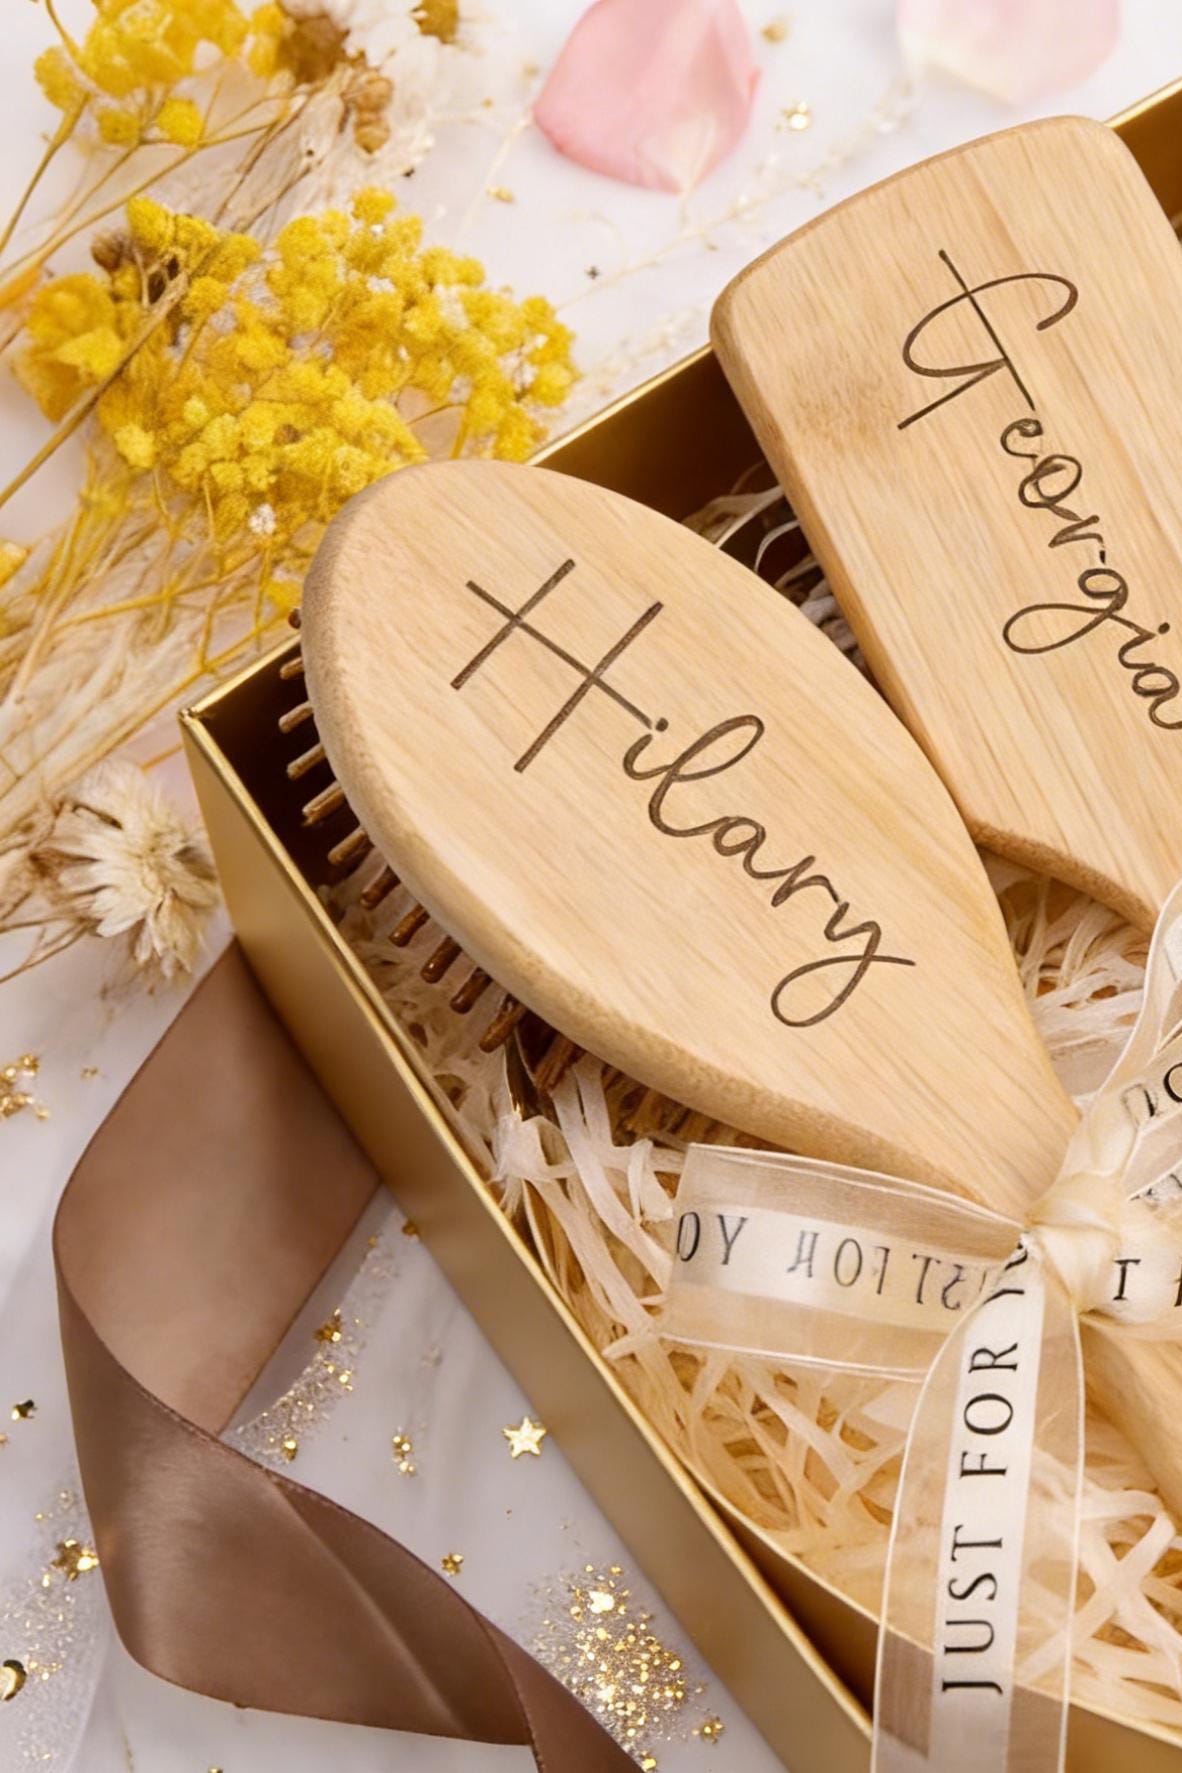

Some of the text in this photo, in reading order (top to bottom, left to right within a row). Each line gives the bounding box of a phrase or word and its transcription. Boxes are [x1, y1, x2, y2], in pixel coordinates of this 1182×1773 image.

[450, 558, 917, 1028] Hilary
[957, 1340, 1016, 1480] FOR
[940, 1523, 1005, 1695] JUST
